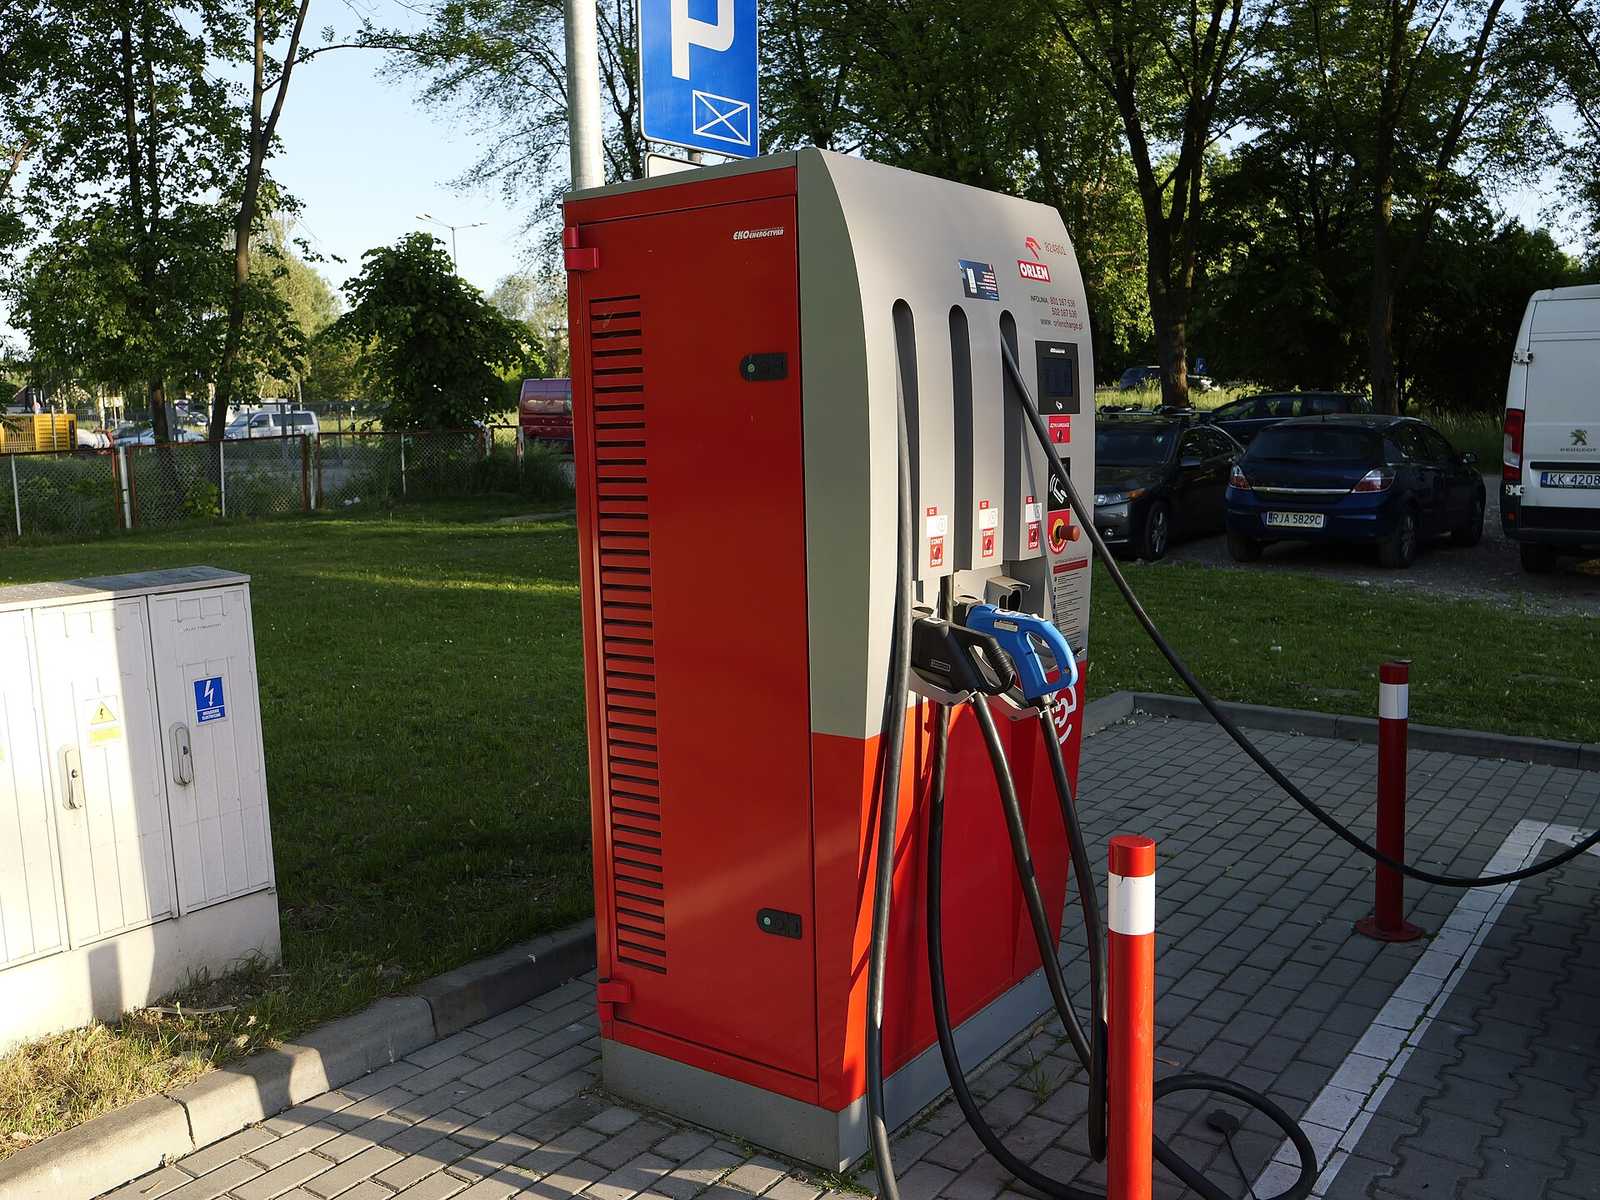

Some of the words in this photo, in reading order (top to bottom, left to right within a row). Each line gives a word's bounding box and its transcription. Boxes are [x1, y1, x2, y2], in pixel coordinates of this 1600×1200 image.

[671, 0, 735, 80] P
[1020, 262, 1049, 281] ORLEN
[1550, 474, 1565, 486] KK
[1570, 474, 1600, 486] 4208
[1272, 512, 1290, 523] RJA
[1293, 514, 1321, 525] 5829C
